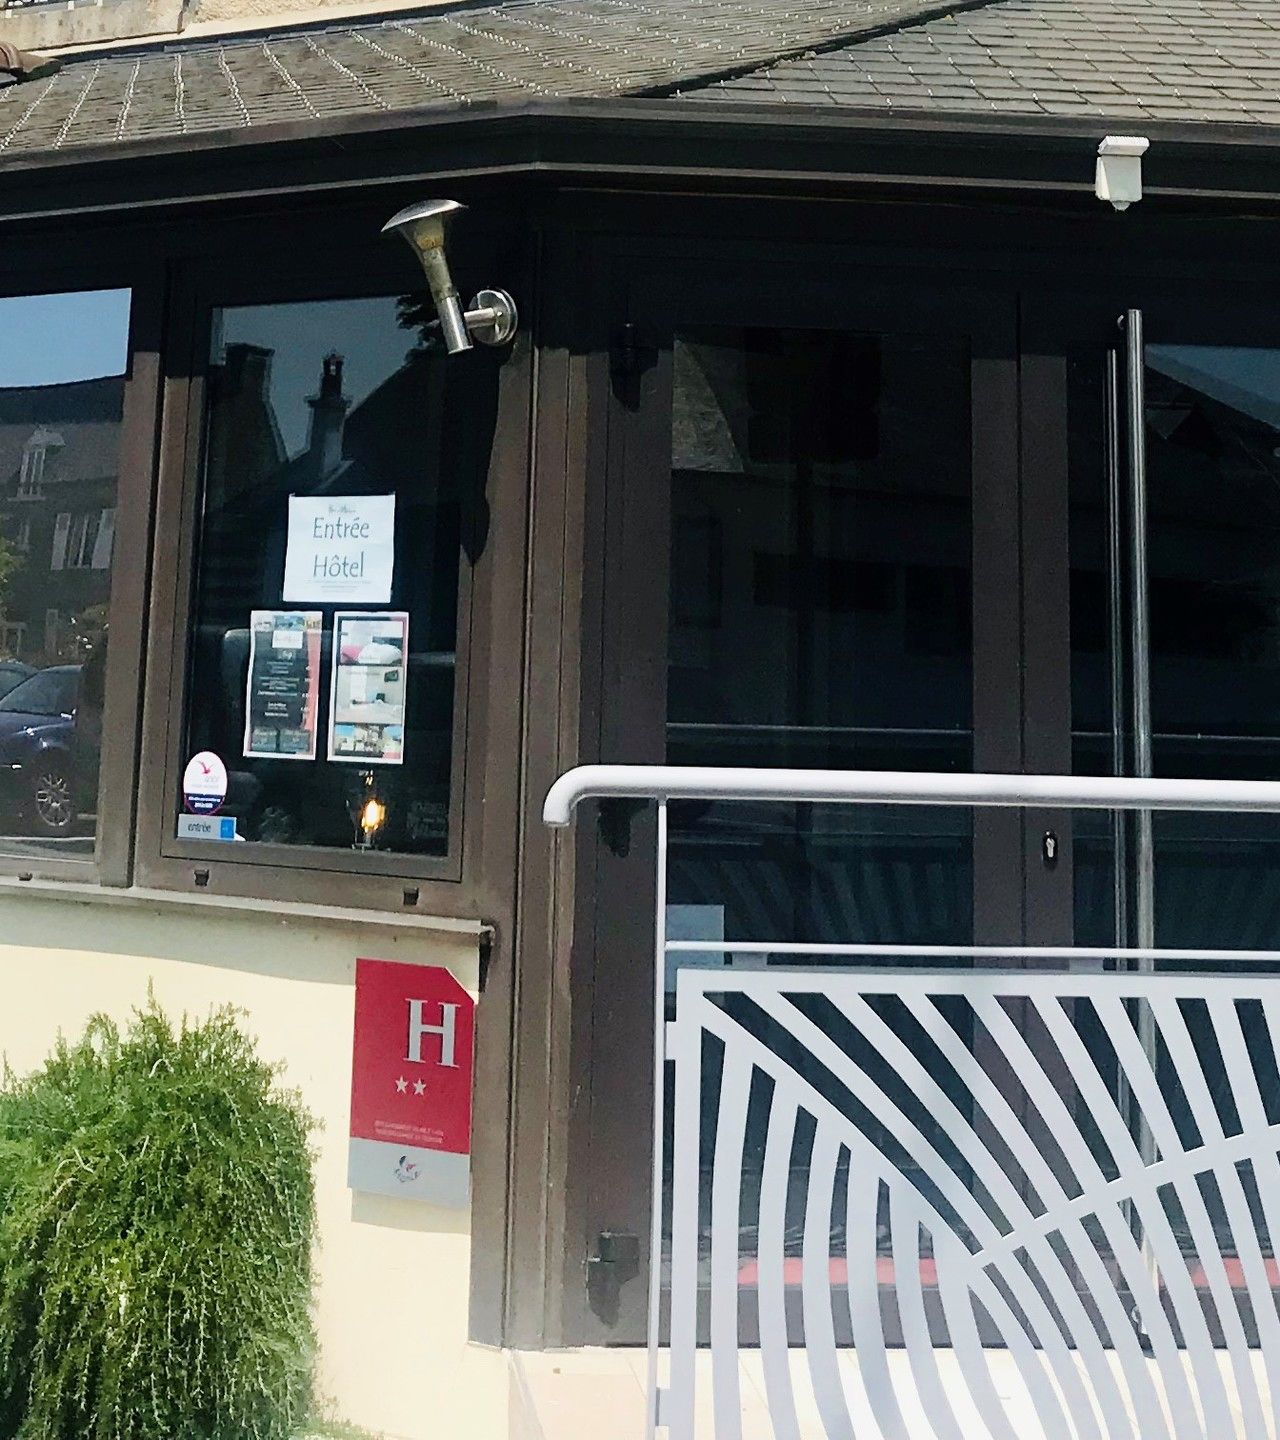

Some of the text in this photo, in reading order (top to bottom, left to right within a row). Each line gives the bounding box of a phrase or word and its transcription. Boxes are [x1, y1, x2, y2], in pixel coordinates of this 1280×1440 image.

[313, 516, 370, 539] Entrée
[313, 551, 364, 578] Hôtel
[403, 998, 461, 1068] H
